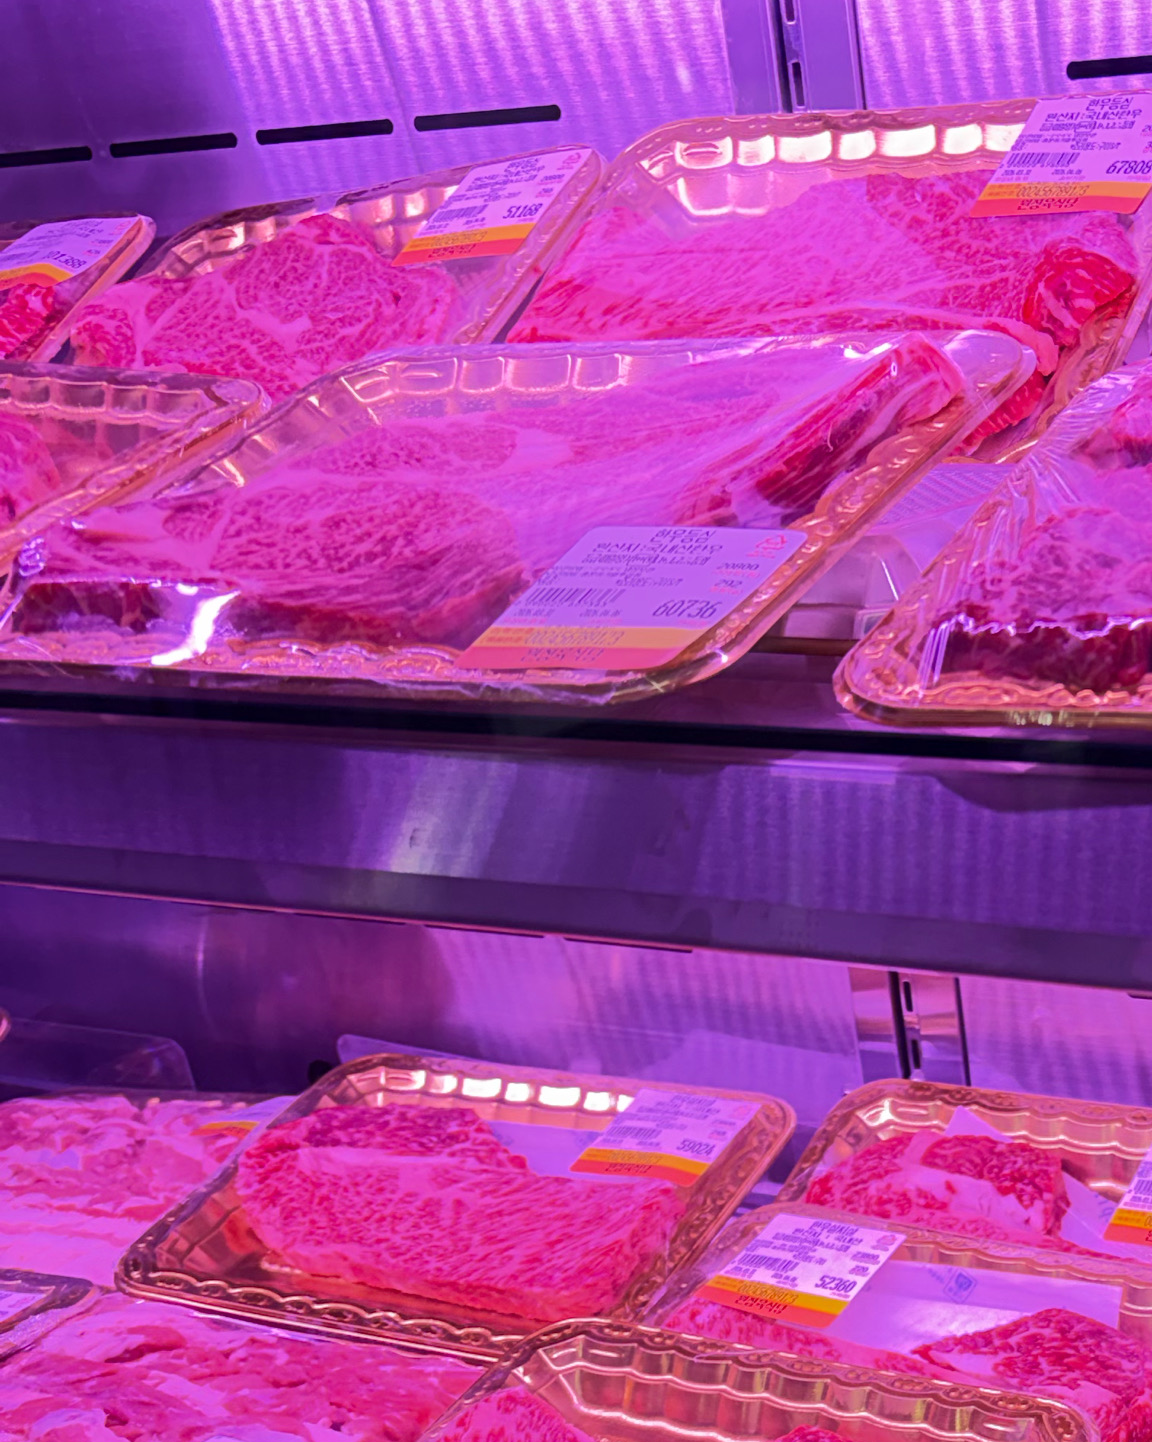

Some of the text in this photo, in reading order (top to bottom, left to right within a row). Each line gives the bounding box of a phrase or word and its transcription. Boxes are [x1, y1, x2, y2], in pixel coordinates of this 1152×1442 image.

[502, 203, 543, 219] 51168
[652, 599, 723, 619] 60736
[676, 1138, 716, 1156] 59024
[815, 1274, 857, 1293] 52360
